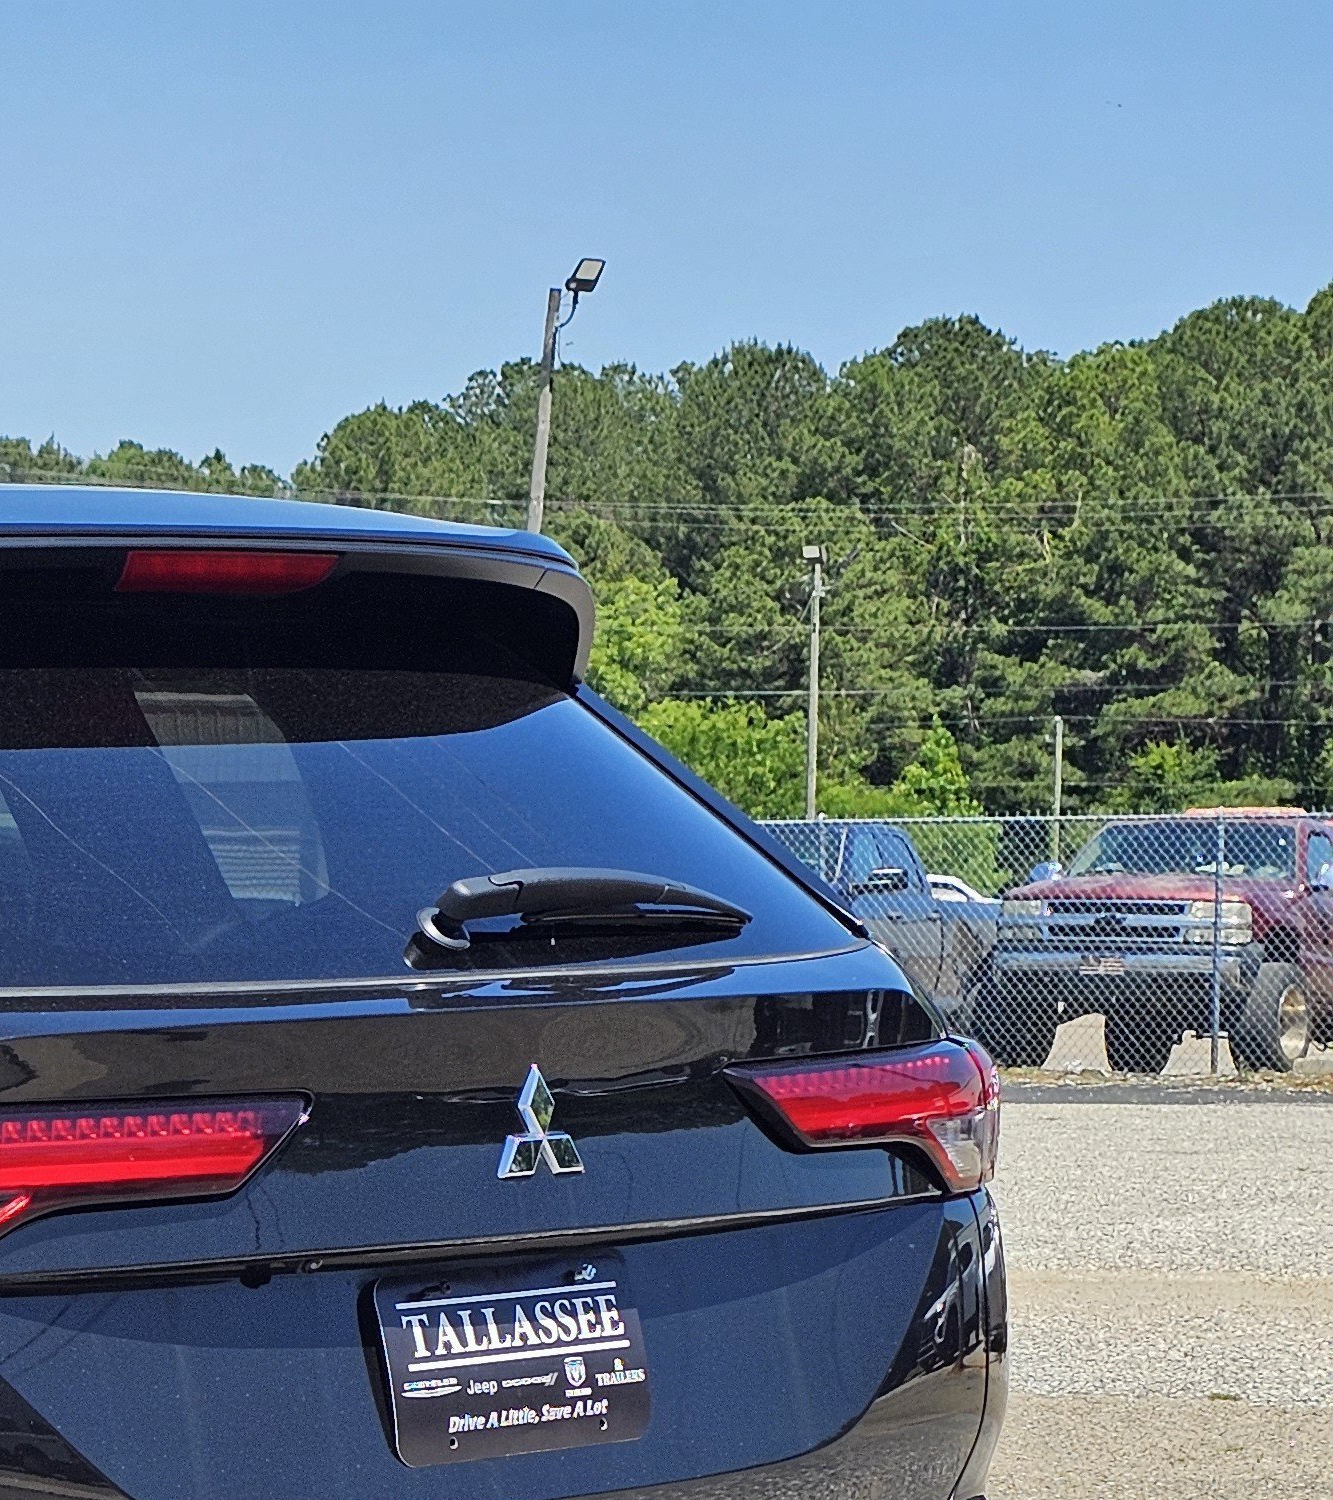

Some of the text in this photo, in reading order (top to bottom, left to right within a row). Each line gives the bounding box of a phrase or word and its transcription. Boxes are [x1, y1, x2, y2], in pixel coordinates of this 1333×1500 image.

[402, 1294, 625, 1359] TALLASSEE
[466, 1380, 498, 1396] Jeep
[448, 1413, 486, 1434] Drive
[486, 1411, 499, 1429] A
[541, 1403, 572, 1422] Save
[573, 1400, 585, 1419] A
[586, 1398, 609, 1417] Lot
